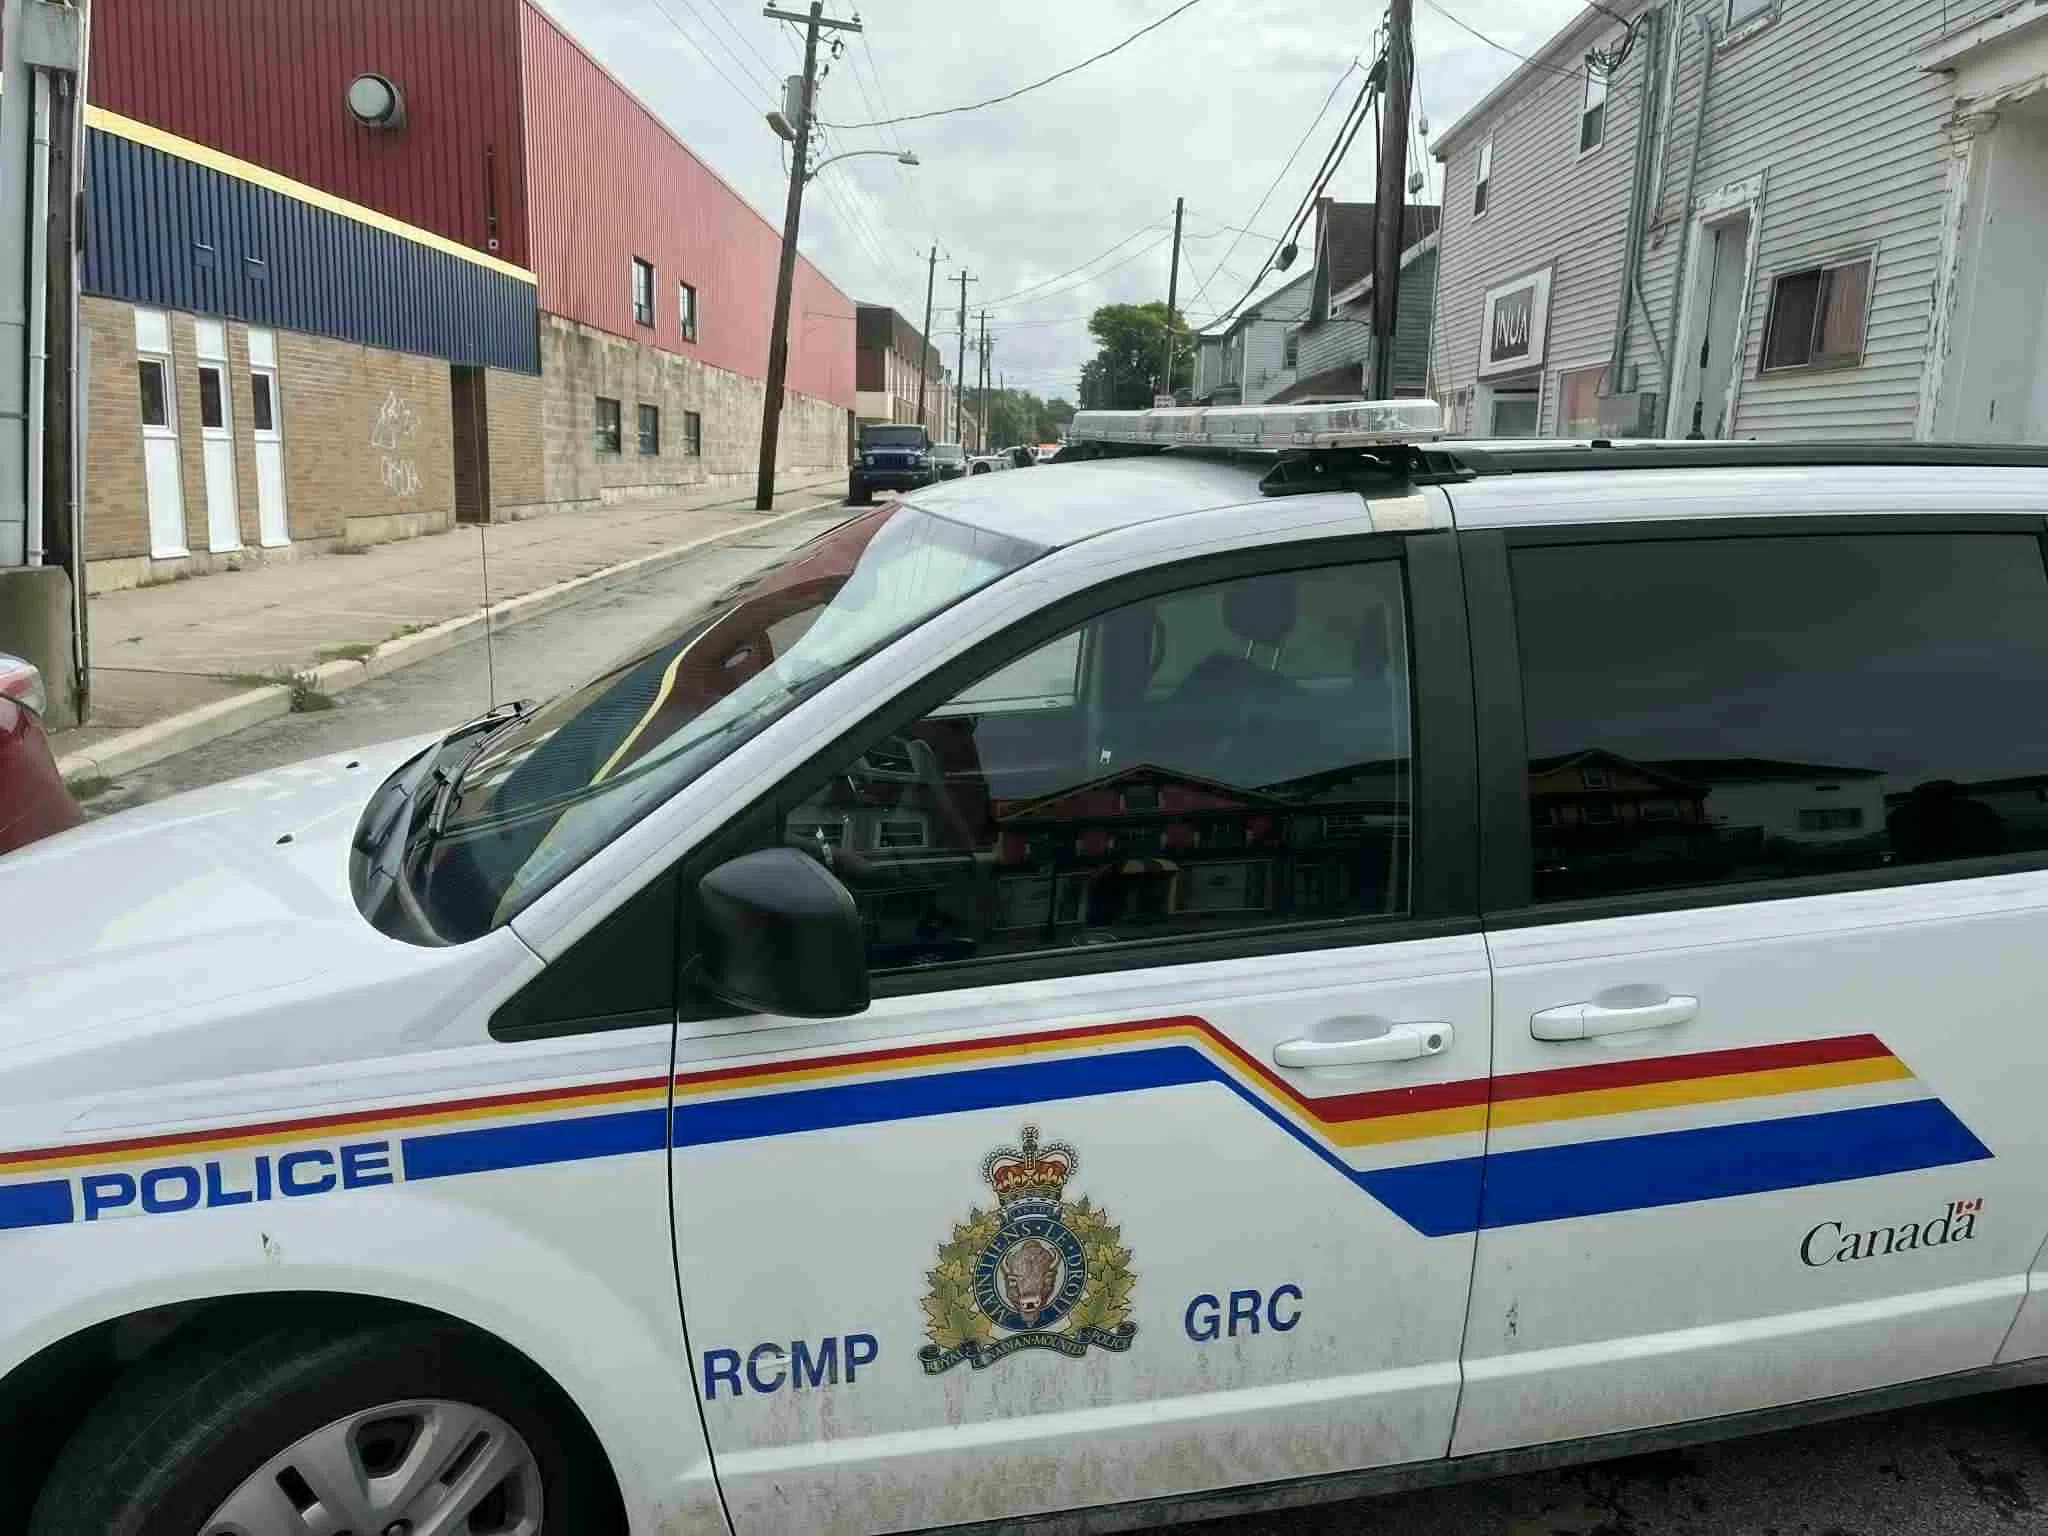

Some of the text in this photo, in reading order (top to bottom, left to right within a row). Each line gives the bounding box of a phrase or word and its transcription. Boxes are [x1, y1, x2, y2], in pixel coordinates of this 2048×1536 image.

[81, 1140, 394, 1222] POLICE
[1799, 1201, 1978, 1268] Canada
[1184, 1283, 1304, 1342] GRC
[703, 1333, 879, 1401] RCMP
